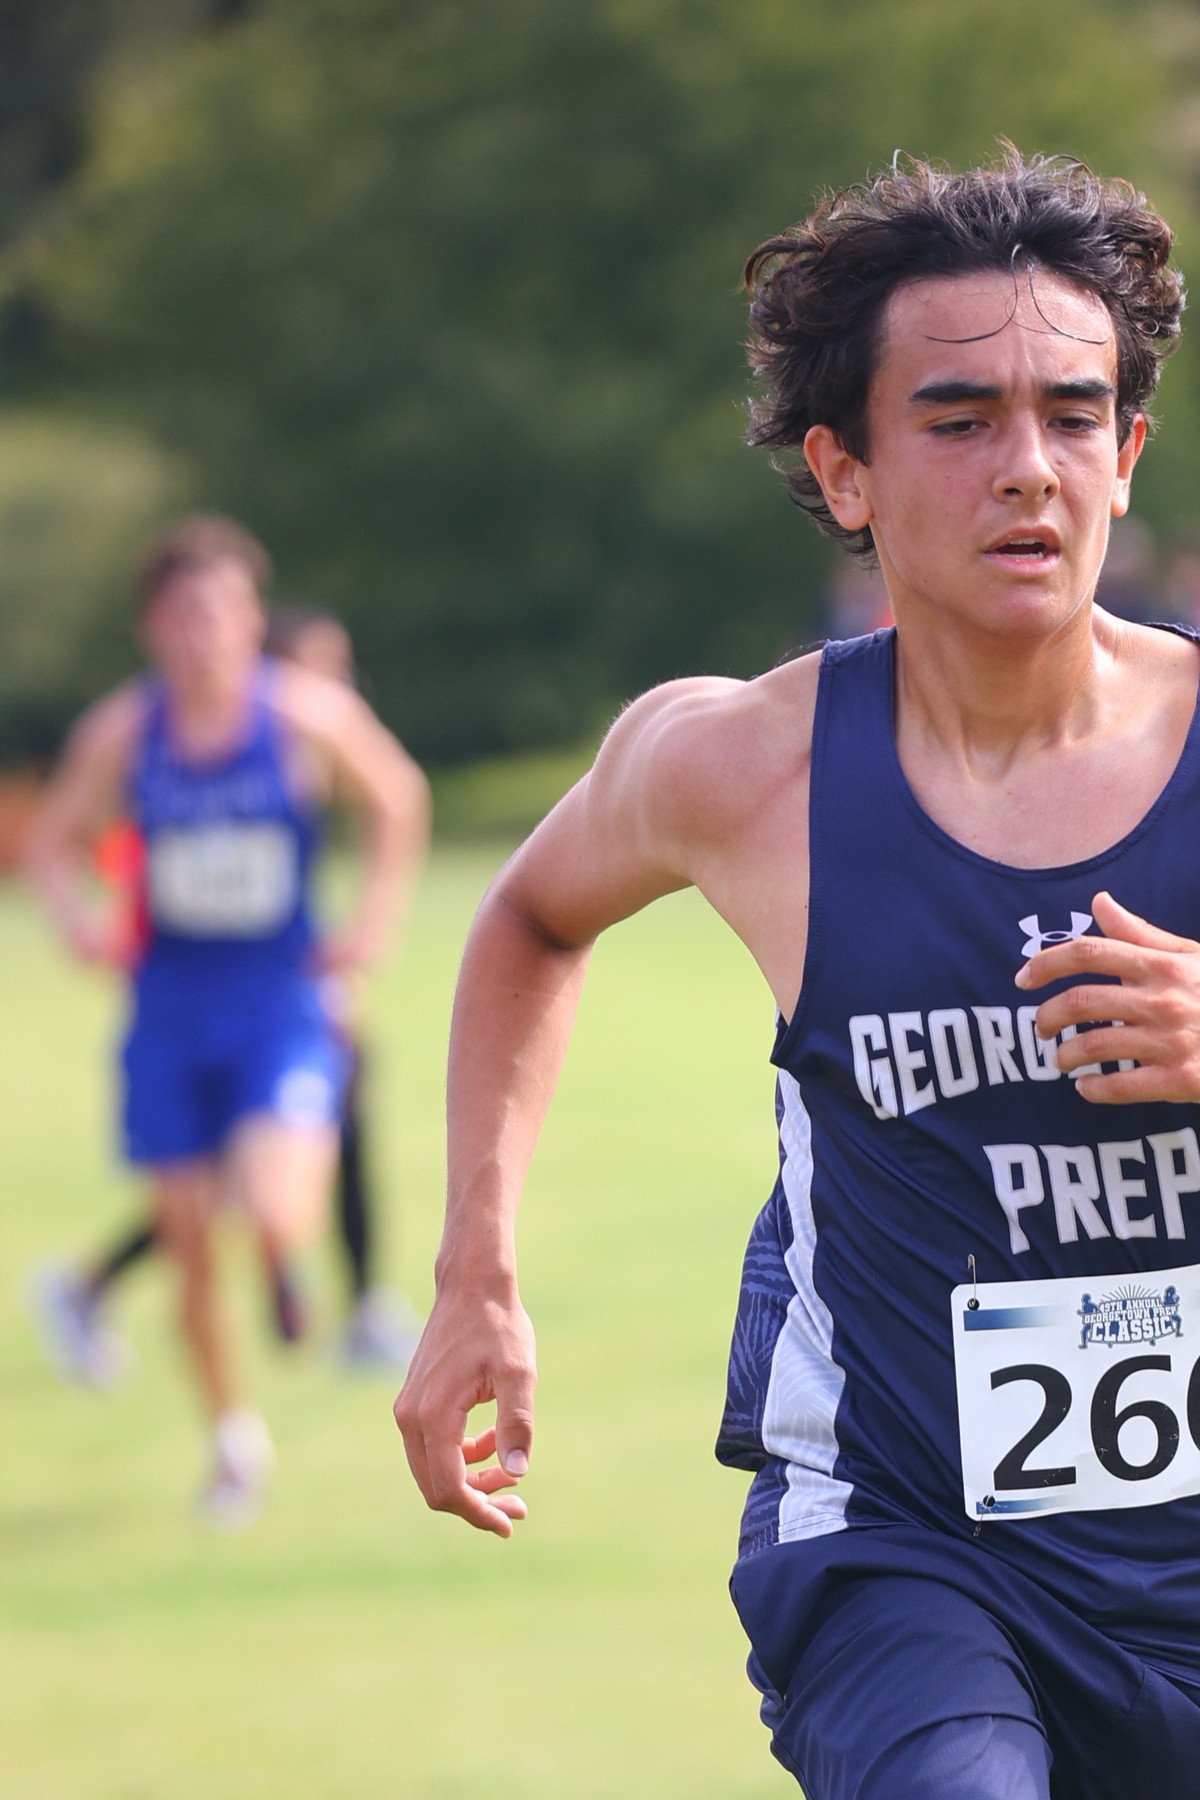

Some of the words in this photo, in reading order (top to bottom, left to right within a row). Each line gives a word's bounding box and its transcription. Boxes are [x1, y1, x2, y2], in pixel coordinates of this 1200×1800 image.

[1125, 1298, 1163, 1310] ANNUAL
[1084, 1308, 1151, 1323] GEORGETOWN
[1153, 1305, 1176, 1318] PREP
[1090, 1315, 1174, 1342] CLASSIC
